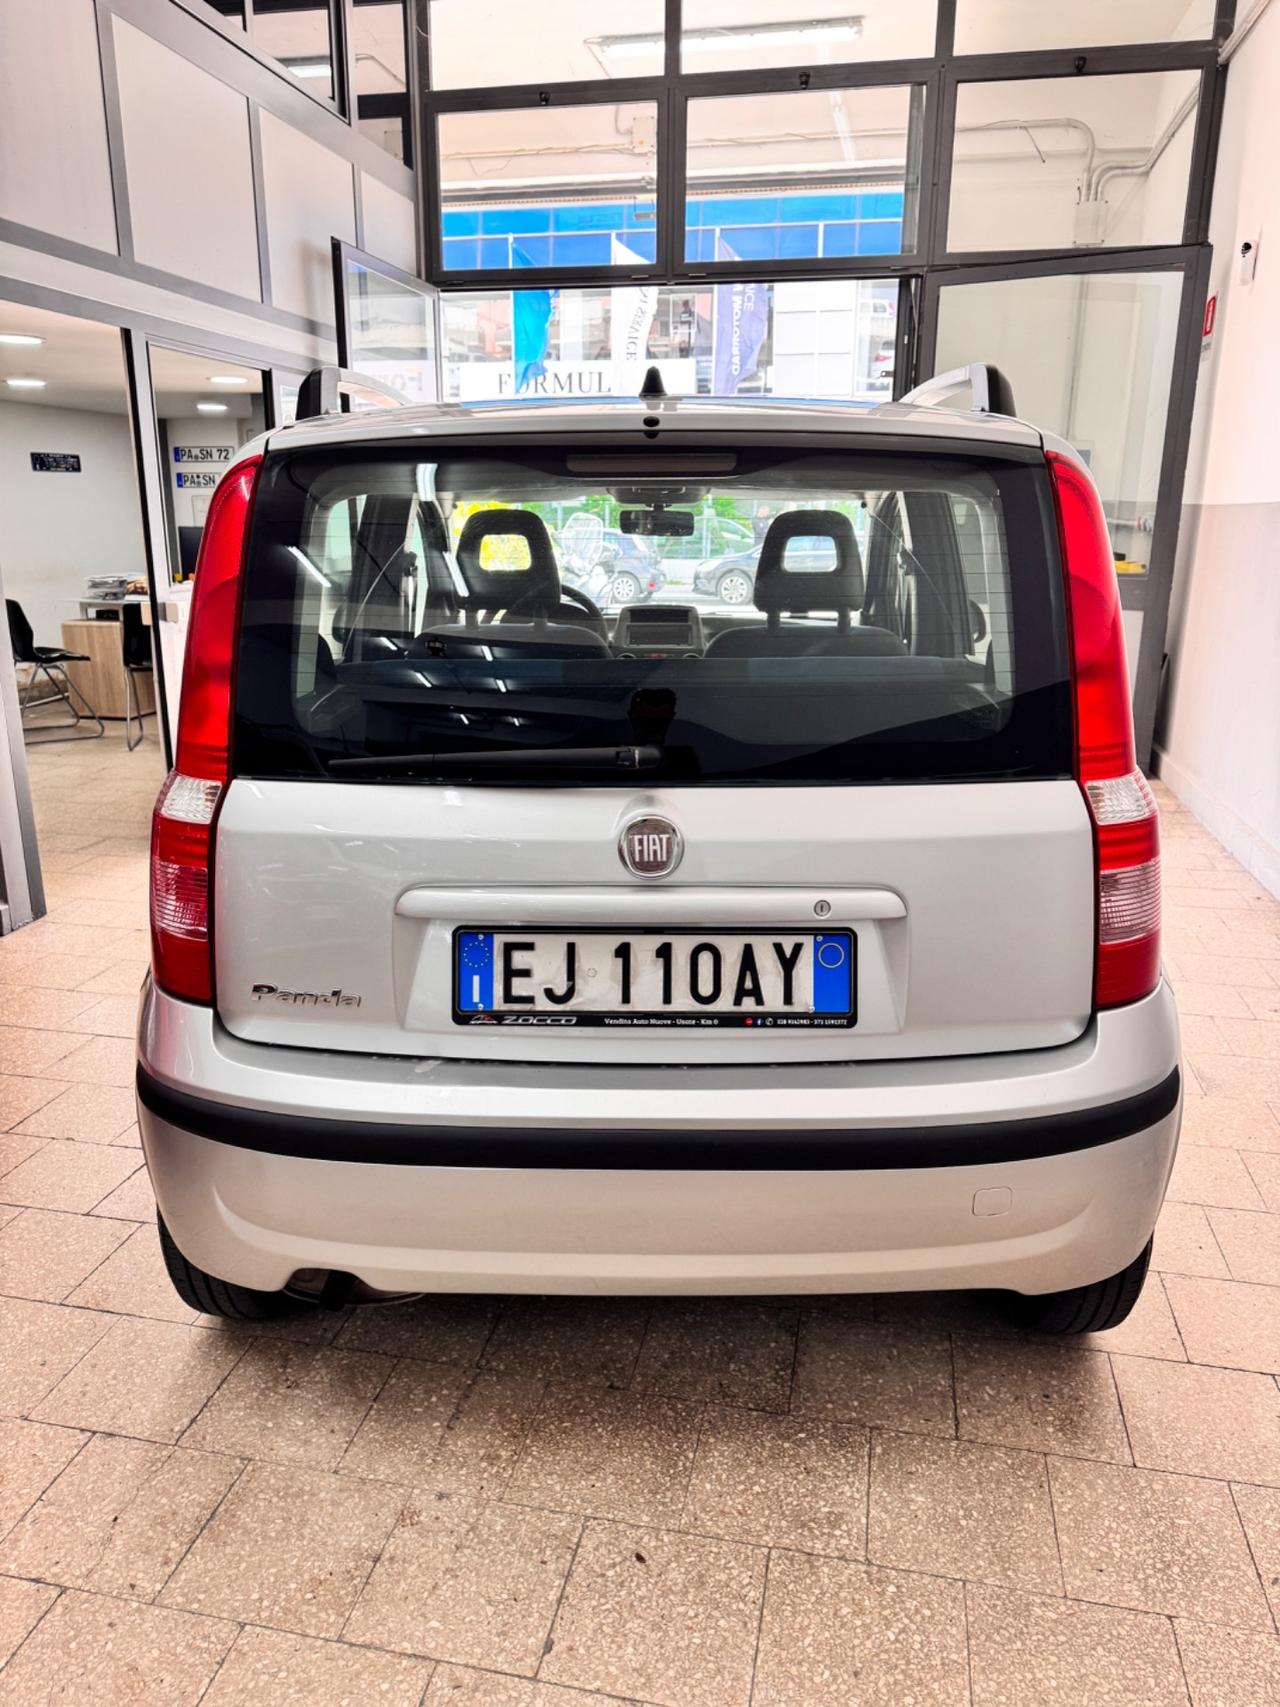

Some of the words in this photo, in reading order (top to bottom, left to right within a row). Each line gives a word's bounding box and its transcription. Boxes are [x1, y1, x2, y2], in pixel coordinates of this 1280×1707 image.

[180, 449, 193, 460] PA
[217, 449, 230, 460] 72
[634, 834, 670, 862] FIAT
[503, 942, 576, 1005] EJ
[252, 984, 361, 1007] Panda
[502, 1016, 577, 1025] ZOCCO
